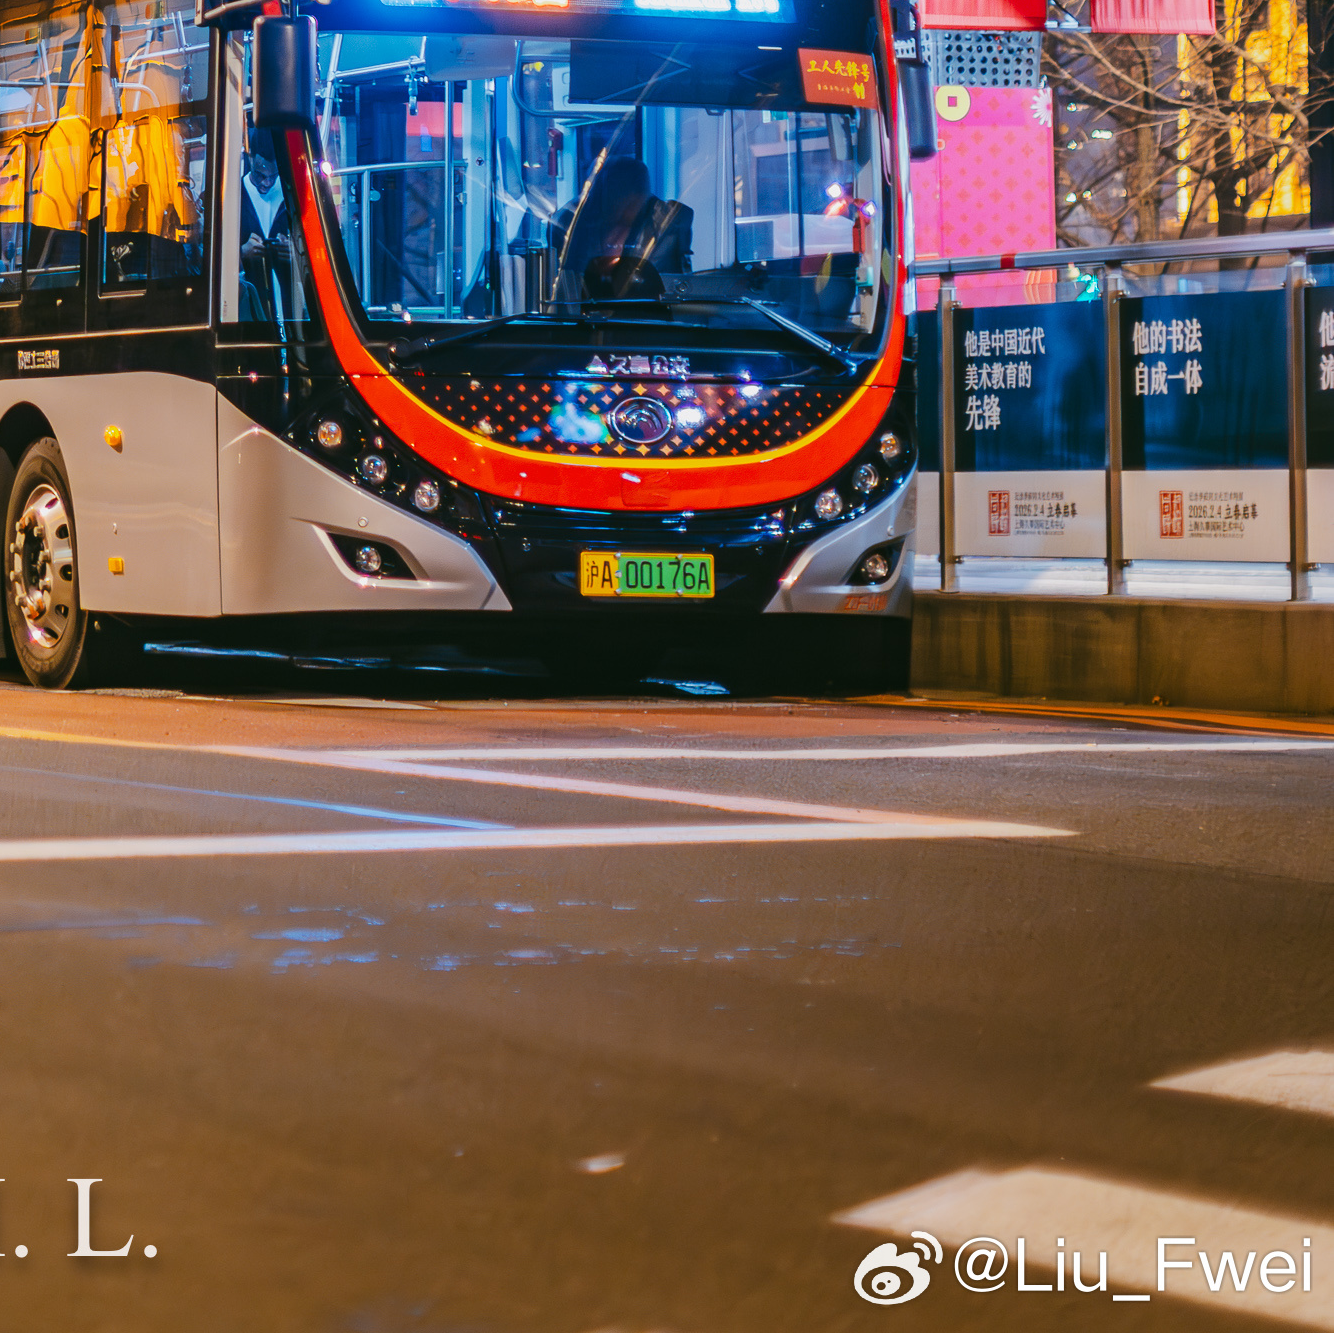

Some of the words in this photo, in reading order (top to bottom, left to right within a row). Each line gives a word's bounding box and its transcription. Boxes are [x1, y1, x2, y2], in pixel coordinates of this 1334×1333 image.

[807, 59, 870, 83] 工人先锋号
[965, 326, 1046, 358] 他是中国近代
[1132, 318, 1203, 355] 他的书法
[965, 361, 1032, 391] 美术教育的
[1135, 359, 1203, 396] 自成一体
[965, 394, 1001, 431] 先锋
